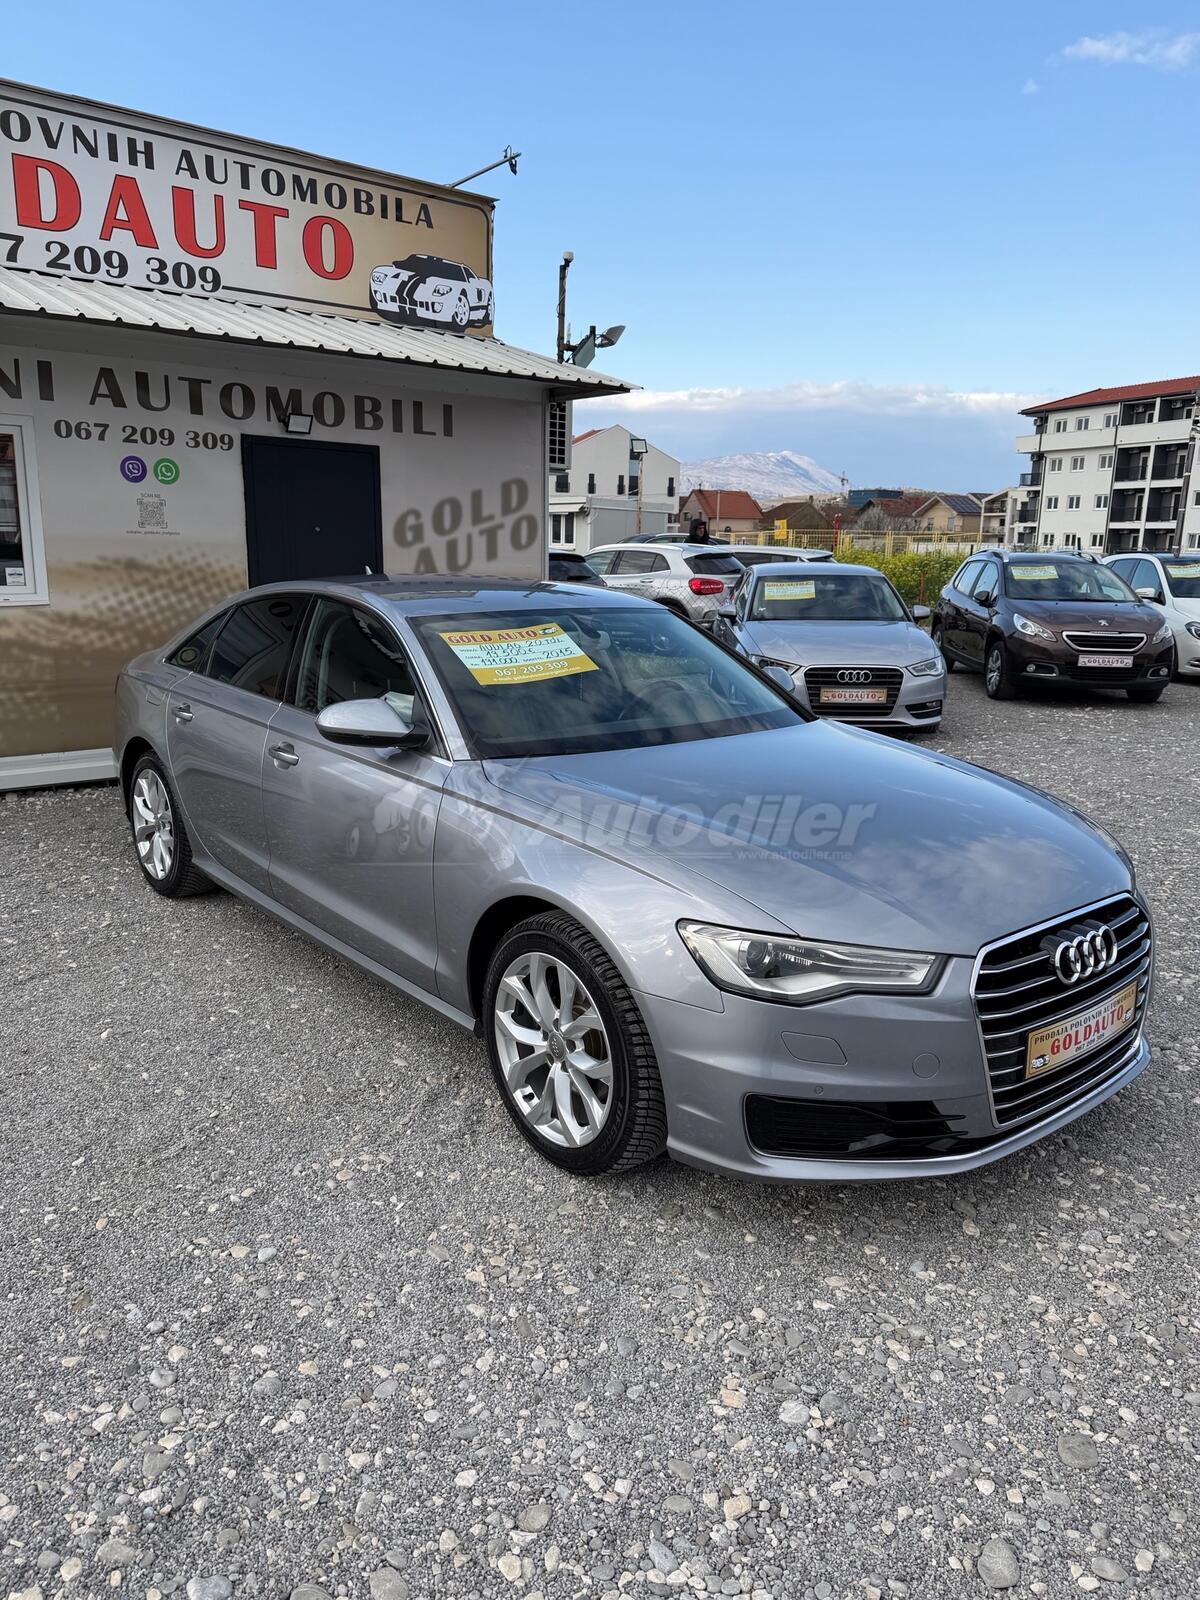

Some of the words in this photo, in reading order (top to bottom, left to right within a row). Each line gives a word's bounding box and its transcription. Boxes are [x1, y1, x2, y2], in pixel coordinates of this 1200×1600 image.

[175, 148, 434, 230] AUTOMOBILA
[11, 152, 354, 281] DAUTO
[44, 241, 129, 279] 209
[145, 257, 222, 293] 309
[89, 366, 454, 438] AUTOMOBILI
[53, 419, 110, 442] 067
[122, 425, 175, 447] 209
[185, 430, 234, 451] 309
[392, 477, 529, 549] GOLD
[413, 513, 538, 574] AUTO
[447, 633, 493, 644] GOLD
[497, 630, 538, 641] AUTO
[495, 667, 517, 677] 067
[523, 664, 545, 674] 209
[546, 661, 569, 670] 309
[1034, 1026, 1069, 1045] PRODAJA
[1070, 1011, 1101, 1031] POLOVNIH
[1050, 1004, 1125, 1056] GOLDAUTO
